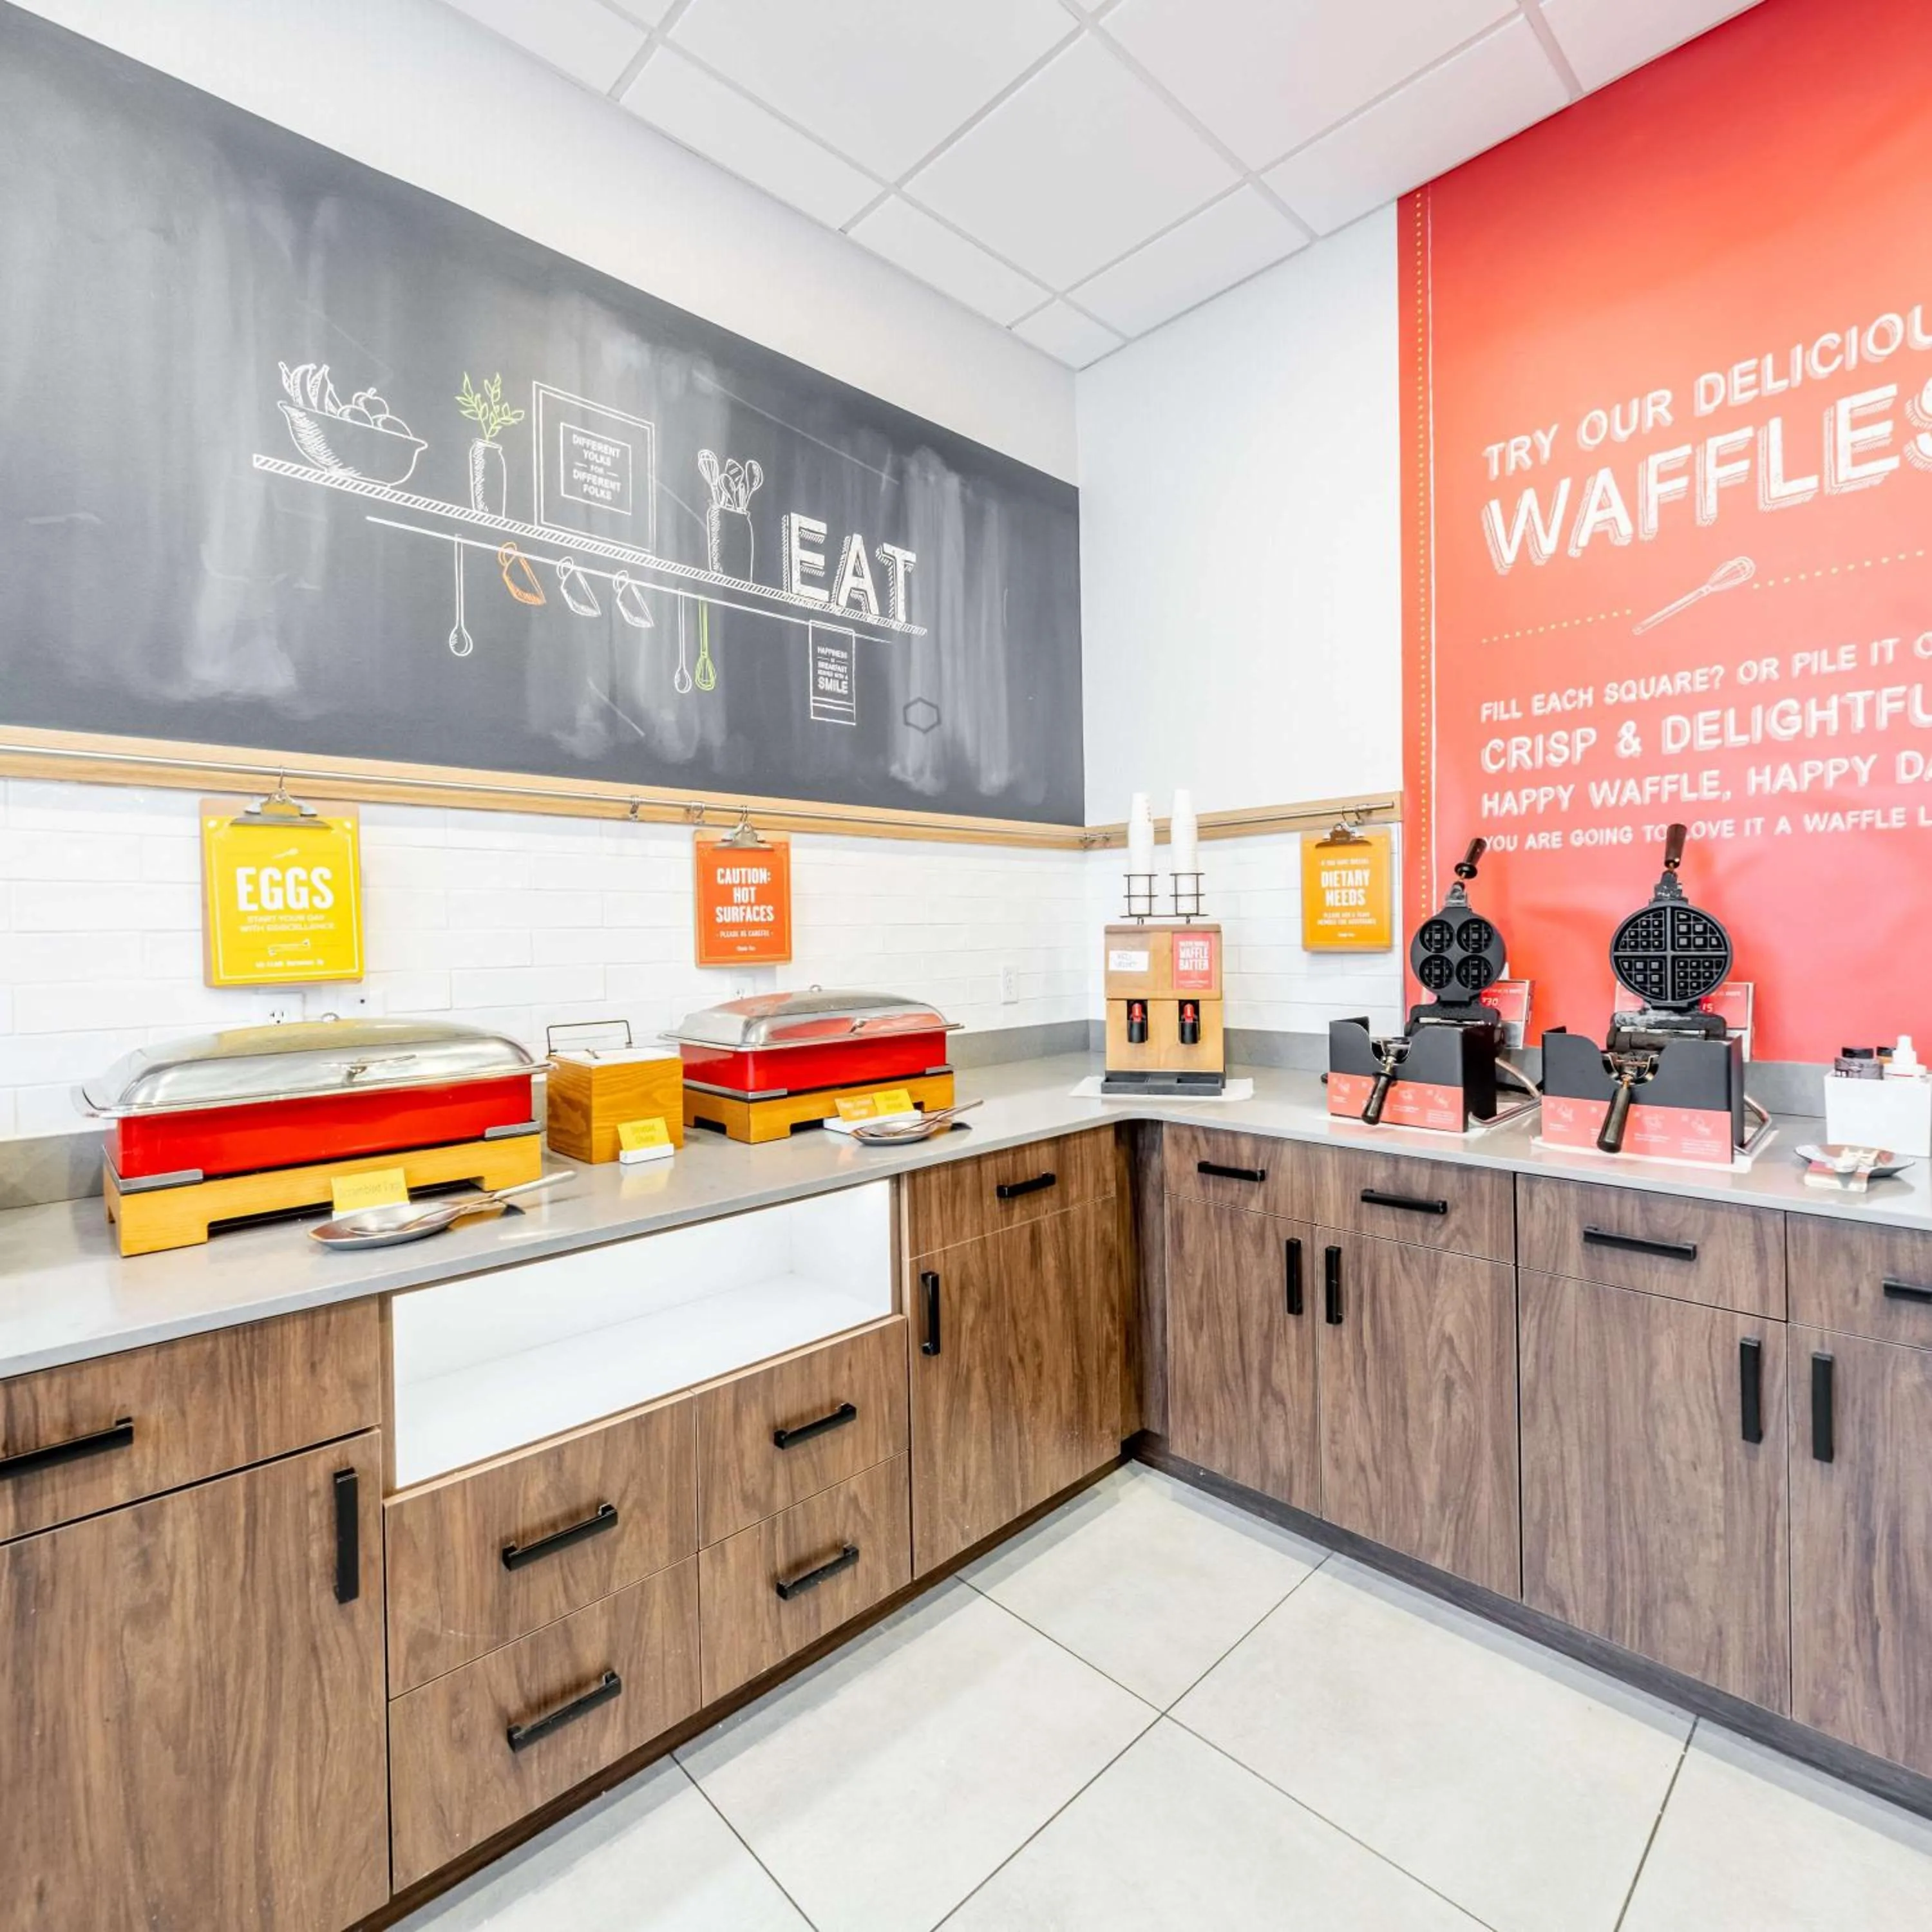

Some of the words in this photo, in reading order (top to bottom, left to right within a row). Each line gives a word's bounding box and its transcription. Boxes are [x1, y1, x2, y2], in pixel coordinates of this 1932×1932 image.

[1483, 424, 1558, 480] TRY
[1577, 388, 1674, 451] OUR
[573, 433, 621, 459] DIFFERENT
[583, 449, 611, 466] YOLKS
[573, 468, 621, 493] DIFFERENT
[1481, 376, 1932, 574] WAFFLE
[583, 484, 612, 500] FOLKS
[782, 512, 916, 623] EAT
[817, 676, 848, 694] SMILE
[1481, 698, 1522, 723] FILL
[1531, 685, 1594, 716] EACH
[1604, 665, 1725, 706] SQUARE?
[1737, 657, 1779, 685] OR
[1792, 643, 1857, 678] PILE
[1870, 637, 1900, 667] IT
[1481, 726, 1597, 774] CRISP
[1616, 720, 1643, 758] &
[1481, 784, 1575, 818] HAPPY
[1588, 769, 1732, 808] WAFFLE,
[1747, 753, 1877, 797] HAPPY
[1482, 833, 1518, 852] YOU
[1524, 830, 1563, 850] ARE
[1569, 826, 1634, 846] GOING
[1643, 824, 1670, 843] TO
[1686, 819, 1735, 840] OVE
[1744, 817, 1765, 836] IT
[1774, 815, 1792, 835] A
[1803, 806, 1906, 833] WAFFLE
[717, 867, 771, 885] CAUTION:
[1321, 869, 1370, 888] DIETARY
[236, 866, 334, 911] EGGS
[733, 886, 757, 904] HOT
[1325, 888, 1366, 907] NEEDS
[715, 905, 774, 923] SURFACES
[1179, 947, 1209, 959] WAFFLE
[1179, 959, 1209, 971] BATTER
